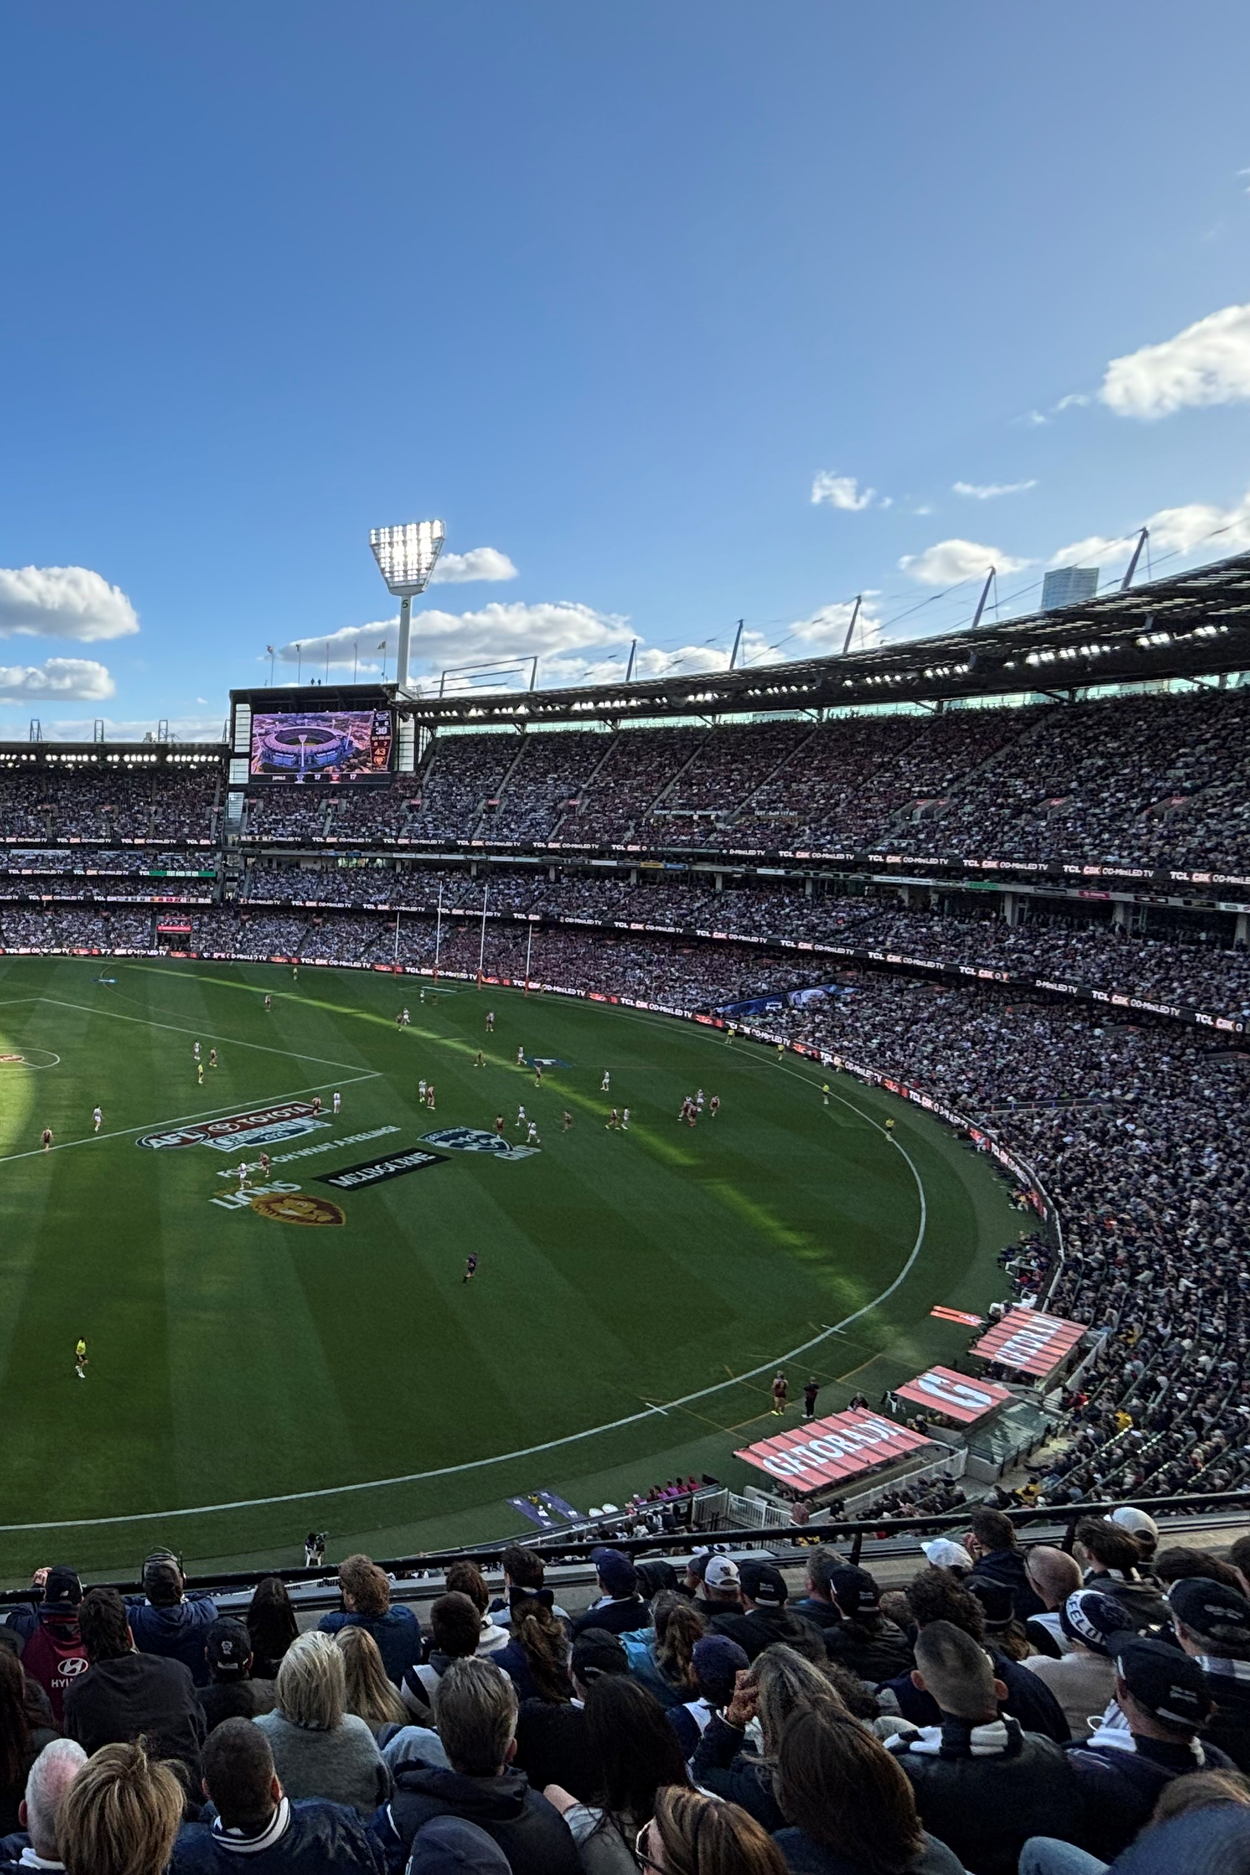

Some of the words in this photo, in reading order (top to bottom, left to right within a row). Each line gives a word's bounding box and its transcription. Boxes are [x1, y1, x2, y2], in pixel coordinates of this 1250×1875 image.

[402, 599, 408, 608] 5
[1063, 865, 1081, 873] TCL
[1170, 871, 1190, 881] TCL
[868, 952, 885, 960] TCL
[959, 966, 976, 975] TCL
[1092, 990, 1109, 1002] TCL
[1195, 1013, 1214, 1026] TCL
[820, 1052, 834, 1062] TCL
[236, 1106, 309, 1125] TOYOTA
[148, 1130, 200, 1148] AFL
[328, 1152, 436, 1187] MELBOURNE
[210, 1180, 302, 1210] LIONS
